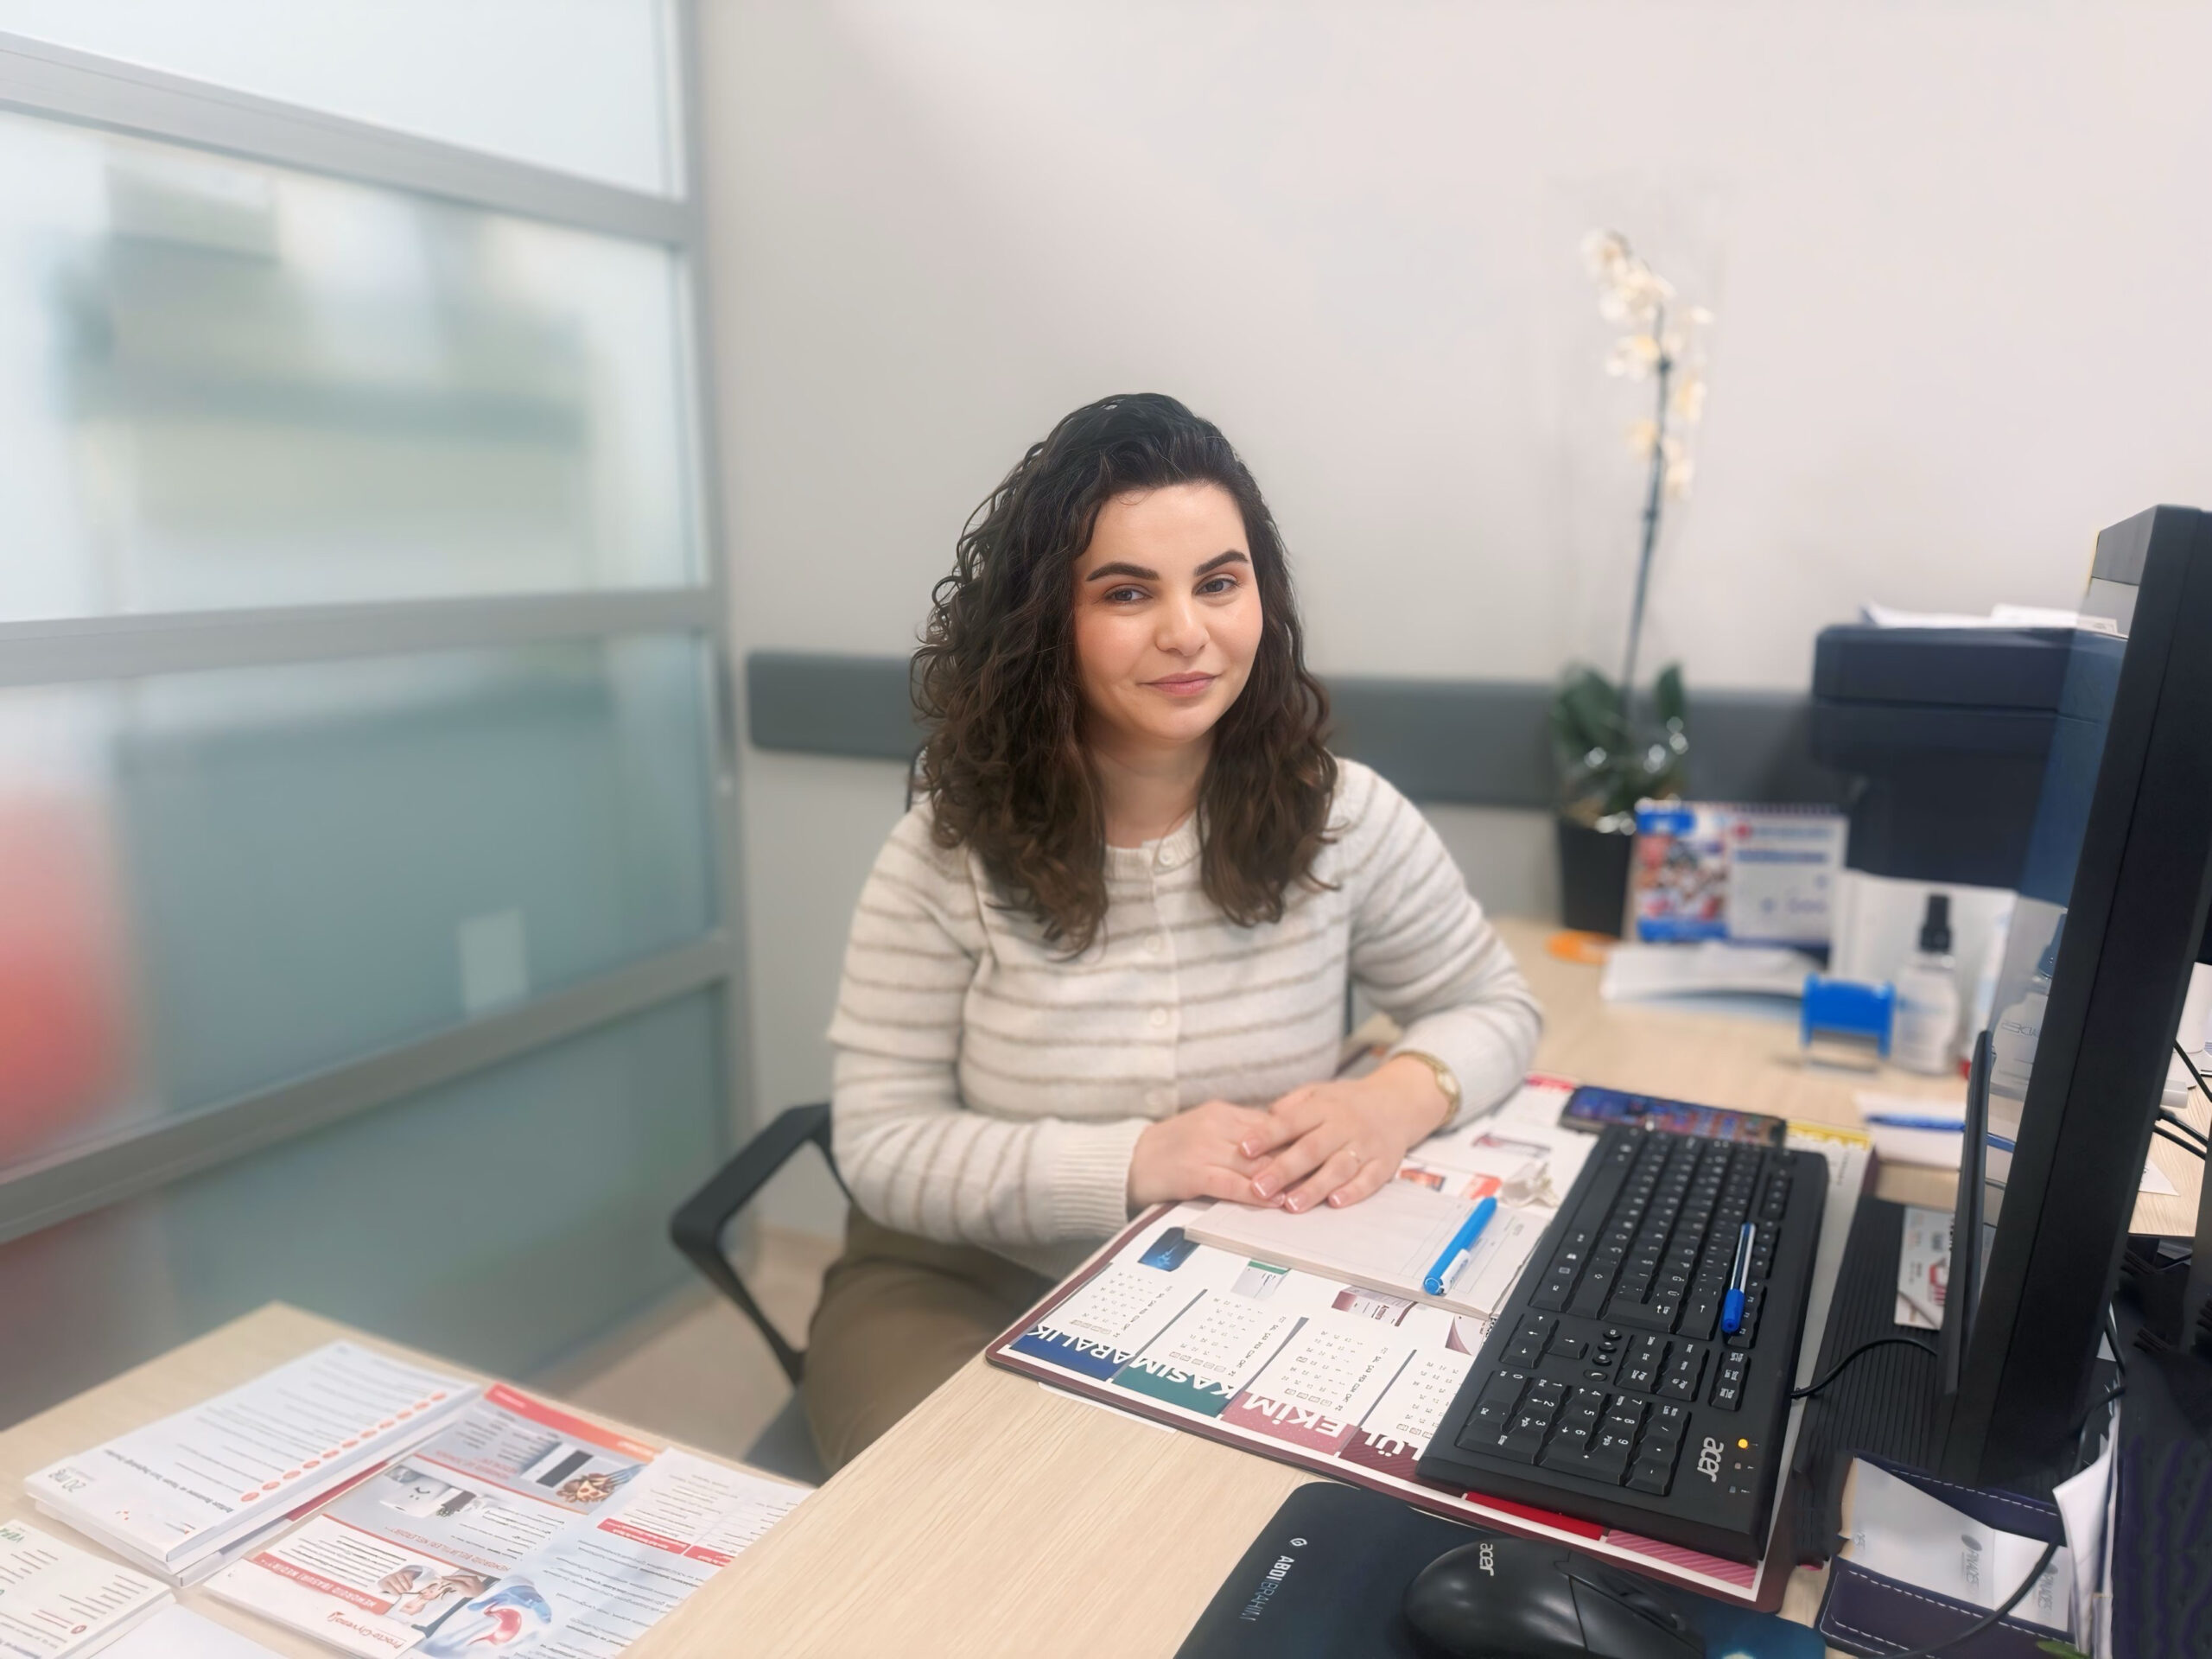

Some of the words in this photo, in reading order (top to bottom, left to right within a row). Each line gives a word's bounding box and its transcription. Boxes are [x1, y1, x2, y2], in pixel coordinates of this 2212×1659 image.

[1027, 1324, 1135, 1364] ARALIK
[1128, 1357, 1237, 1401] KASIM
[1242, 1393, 1348, 1439] EKİM
[1697, 1437, 1725, 1483] acer
[1479, 1542, 1495, 1576] acer
